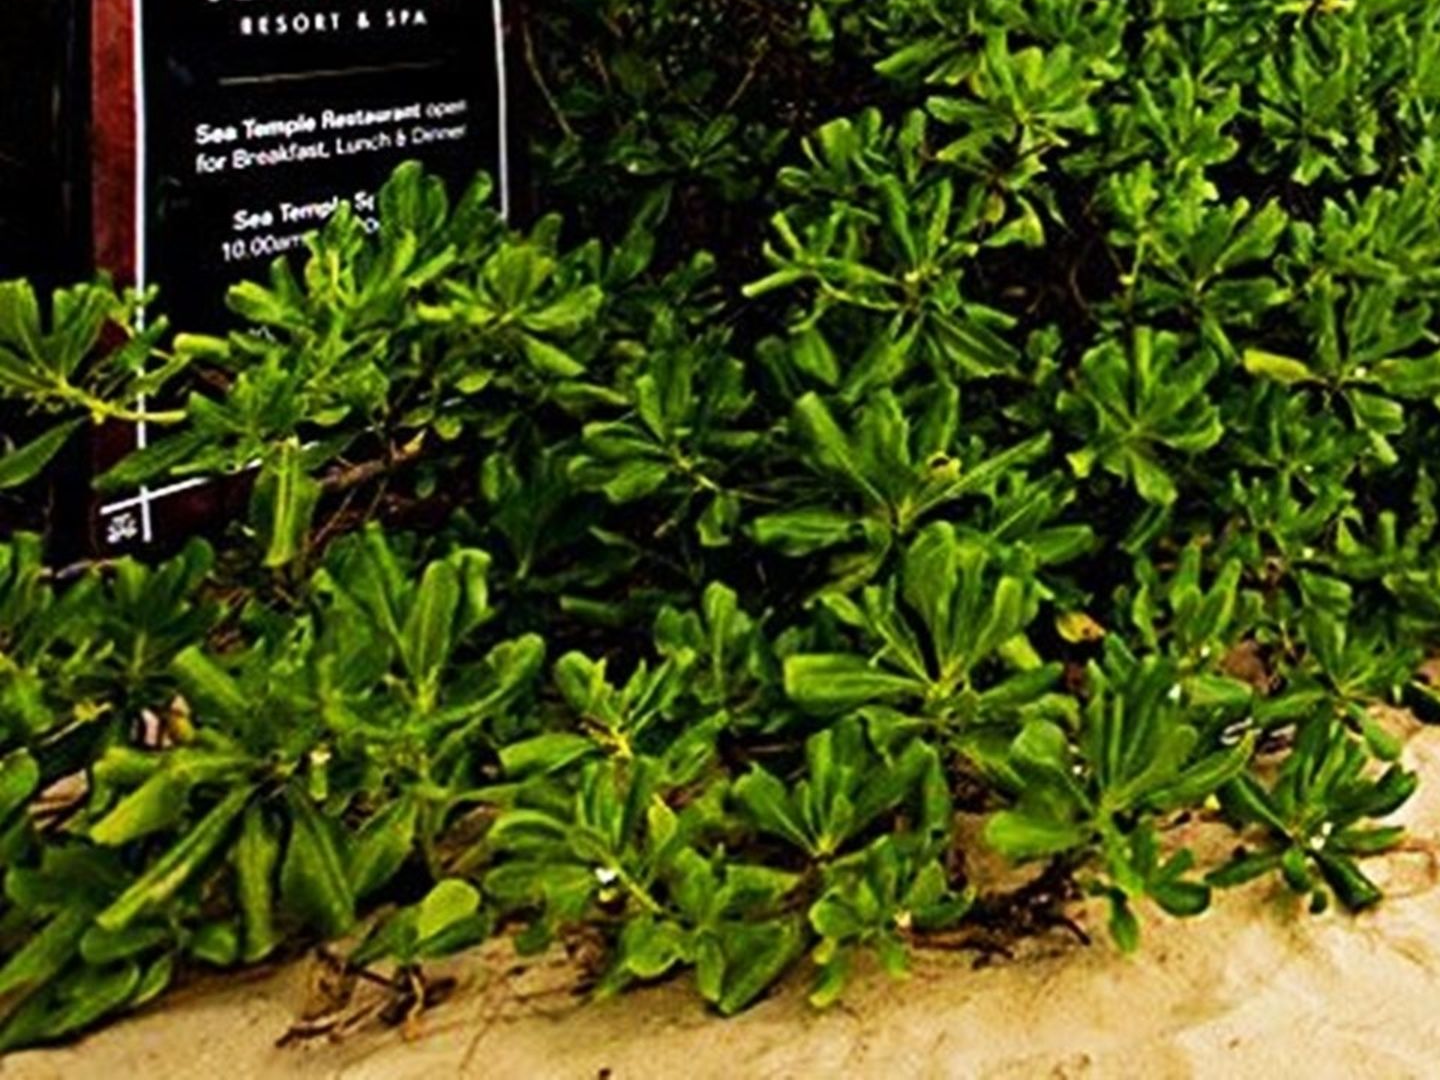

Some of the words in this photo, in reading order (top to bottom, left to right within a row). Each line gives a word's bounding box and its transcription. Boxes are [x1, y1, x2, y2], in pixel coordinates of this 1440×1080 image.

[239, 13, 340, 35] RESORT
[357, 10, 371, 29] &
[385, 9, 427, 27] SPA
[195, 123, 238, 145] Sea
[241, 115, 317, 139] Temple
[321, 108, 421, 130] Restaurant
[425, 99, 467, 119] open
[195, 153, 227, 174] for
[336, 136, 392, 156] Lunch
[411, 122, 466, 144] Dinner
[232, 209, 274, 232] Sea
[279, 195, 340, 223] Templ
